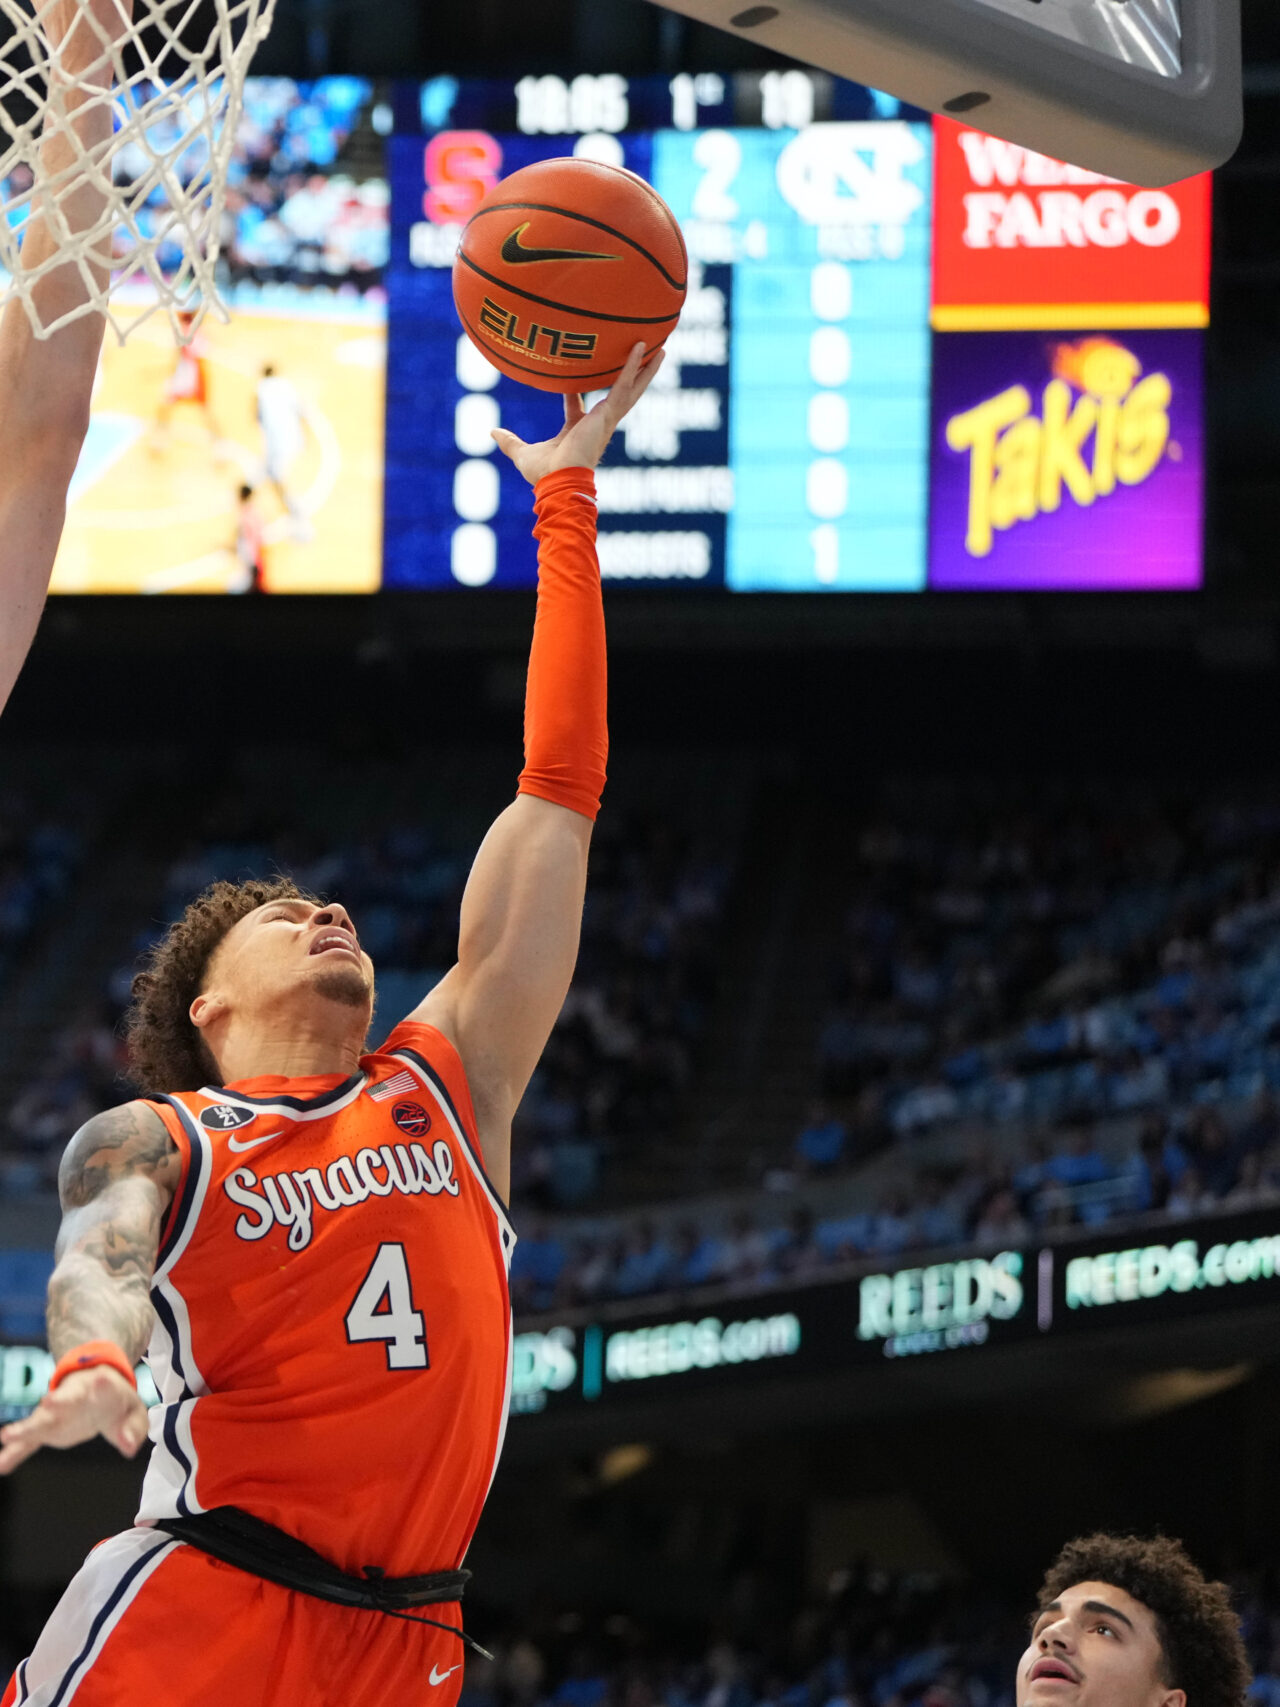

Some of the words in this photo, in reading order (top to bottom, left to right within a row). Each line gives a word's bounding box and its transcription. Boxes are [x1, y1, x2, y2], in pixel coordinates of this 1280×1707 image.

[962, 188, 1181, 249] FARGO
[479, 296, 598, 360] ELITE
[223, 1140, 460, 1252] Syracuse
[343, 1241, 430, 1371] 4
[857, 1250, 1024, 1341] REEDS
